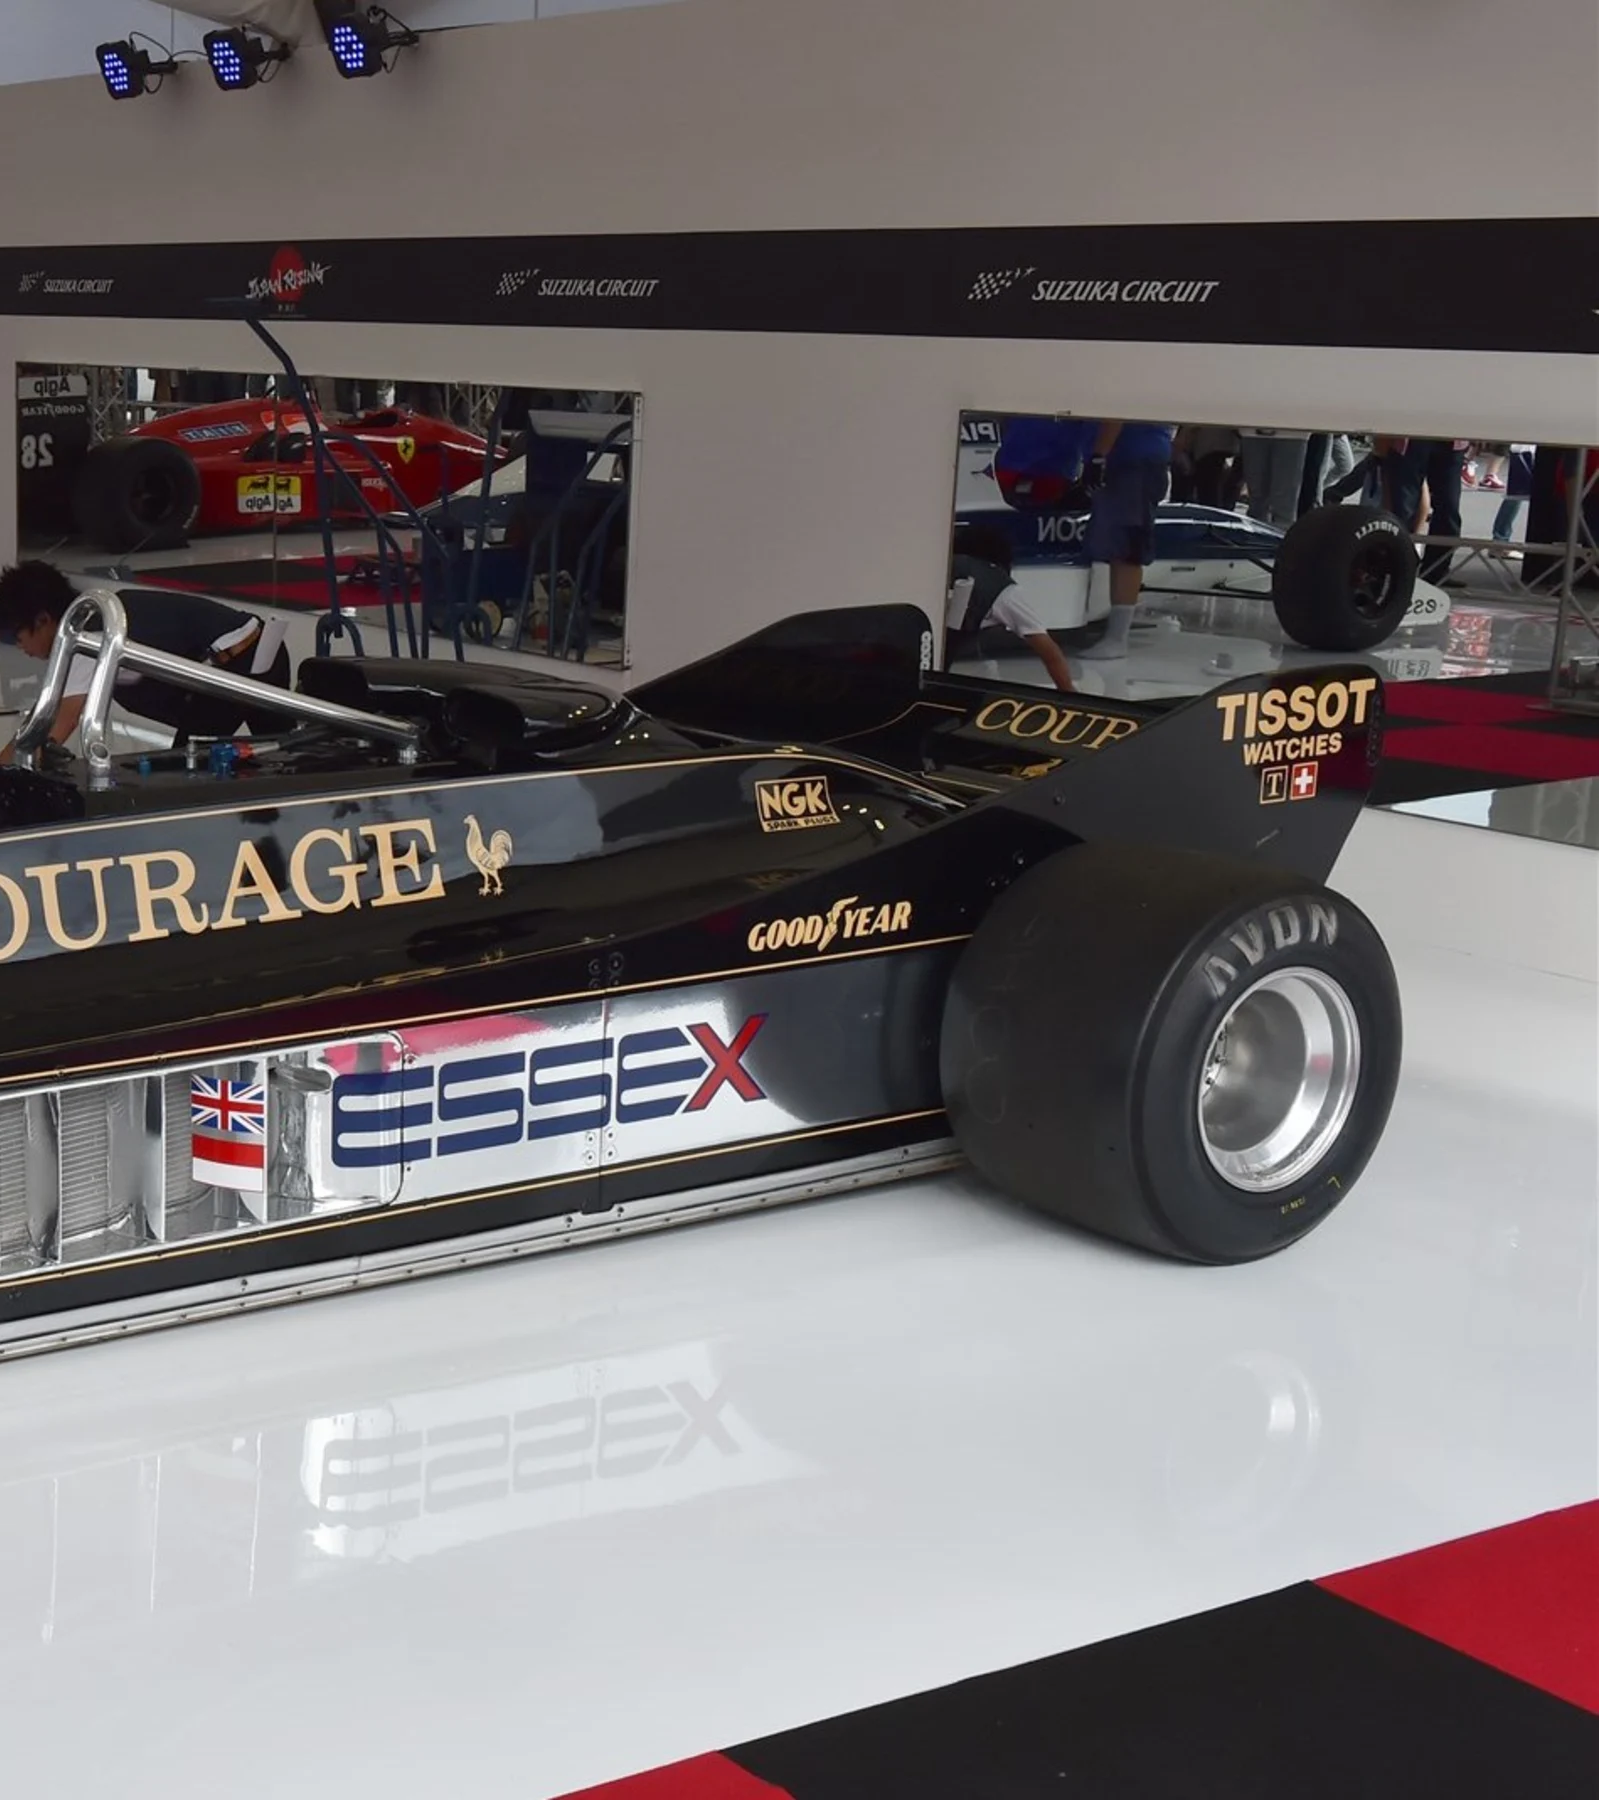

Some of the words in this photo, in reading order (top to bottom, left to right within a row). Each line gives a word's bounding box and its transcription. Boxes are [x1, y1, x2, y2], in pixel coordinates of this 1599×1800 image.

[43, 279, 77, 293] SUZUKA
[77, 279, 115, 294] CIRCUIT
[538, 279, 594, 296] SUZUKA
[596, 279, 659, 297] CIRCUIT
[1031, 280, 1119, 301] SUZUKA
[1121, 281, 1220, 302] CIRCUIT
[1216, 678, 1377, 742] TISSOT
[1242, 731, 1343, 766] WATCHES
[759, 782, 828, 819] NGK
[747, 895, 912, 952] GOODYEAR
[1203, 903, 1338, 1000] AVON
[331, 1012, 770, 1169] ESSEX
